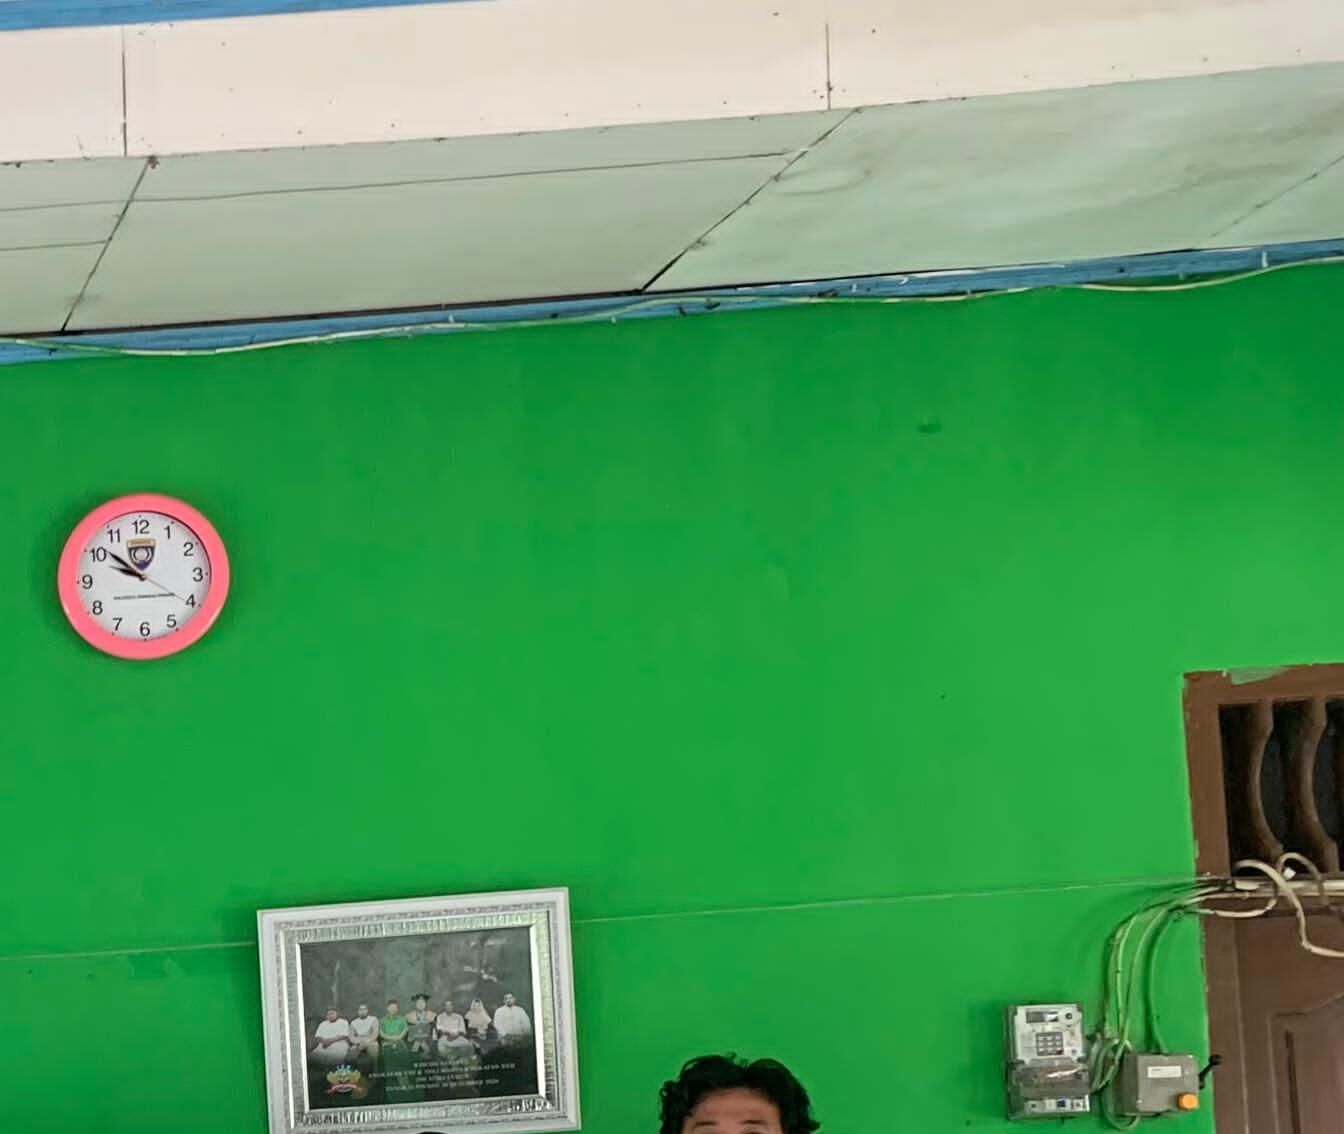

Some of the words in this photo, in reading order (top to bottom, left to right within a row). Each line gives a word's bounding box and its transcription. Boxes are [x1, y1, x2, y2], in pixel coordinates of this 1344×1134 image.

[132, 519, 150, 535] 12
[164, 526, 171, 539] 1
[108, 529, 121, 543] 11
[91, 547, 107, 562] 10
[183, 542, 194, 557] 2
[82, 574, 93, 589] 9
[193, 568, 203, 582] 3
[92, 600, 103, 615] 8
[185, 594, 195, 609] 4
[113, 617, 122, 631] 7
[166, 614, 177, 628] 5
[139, 622, 150, 637] 6
